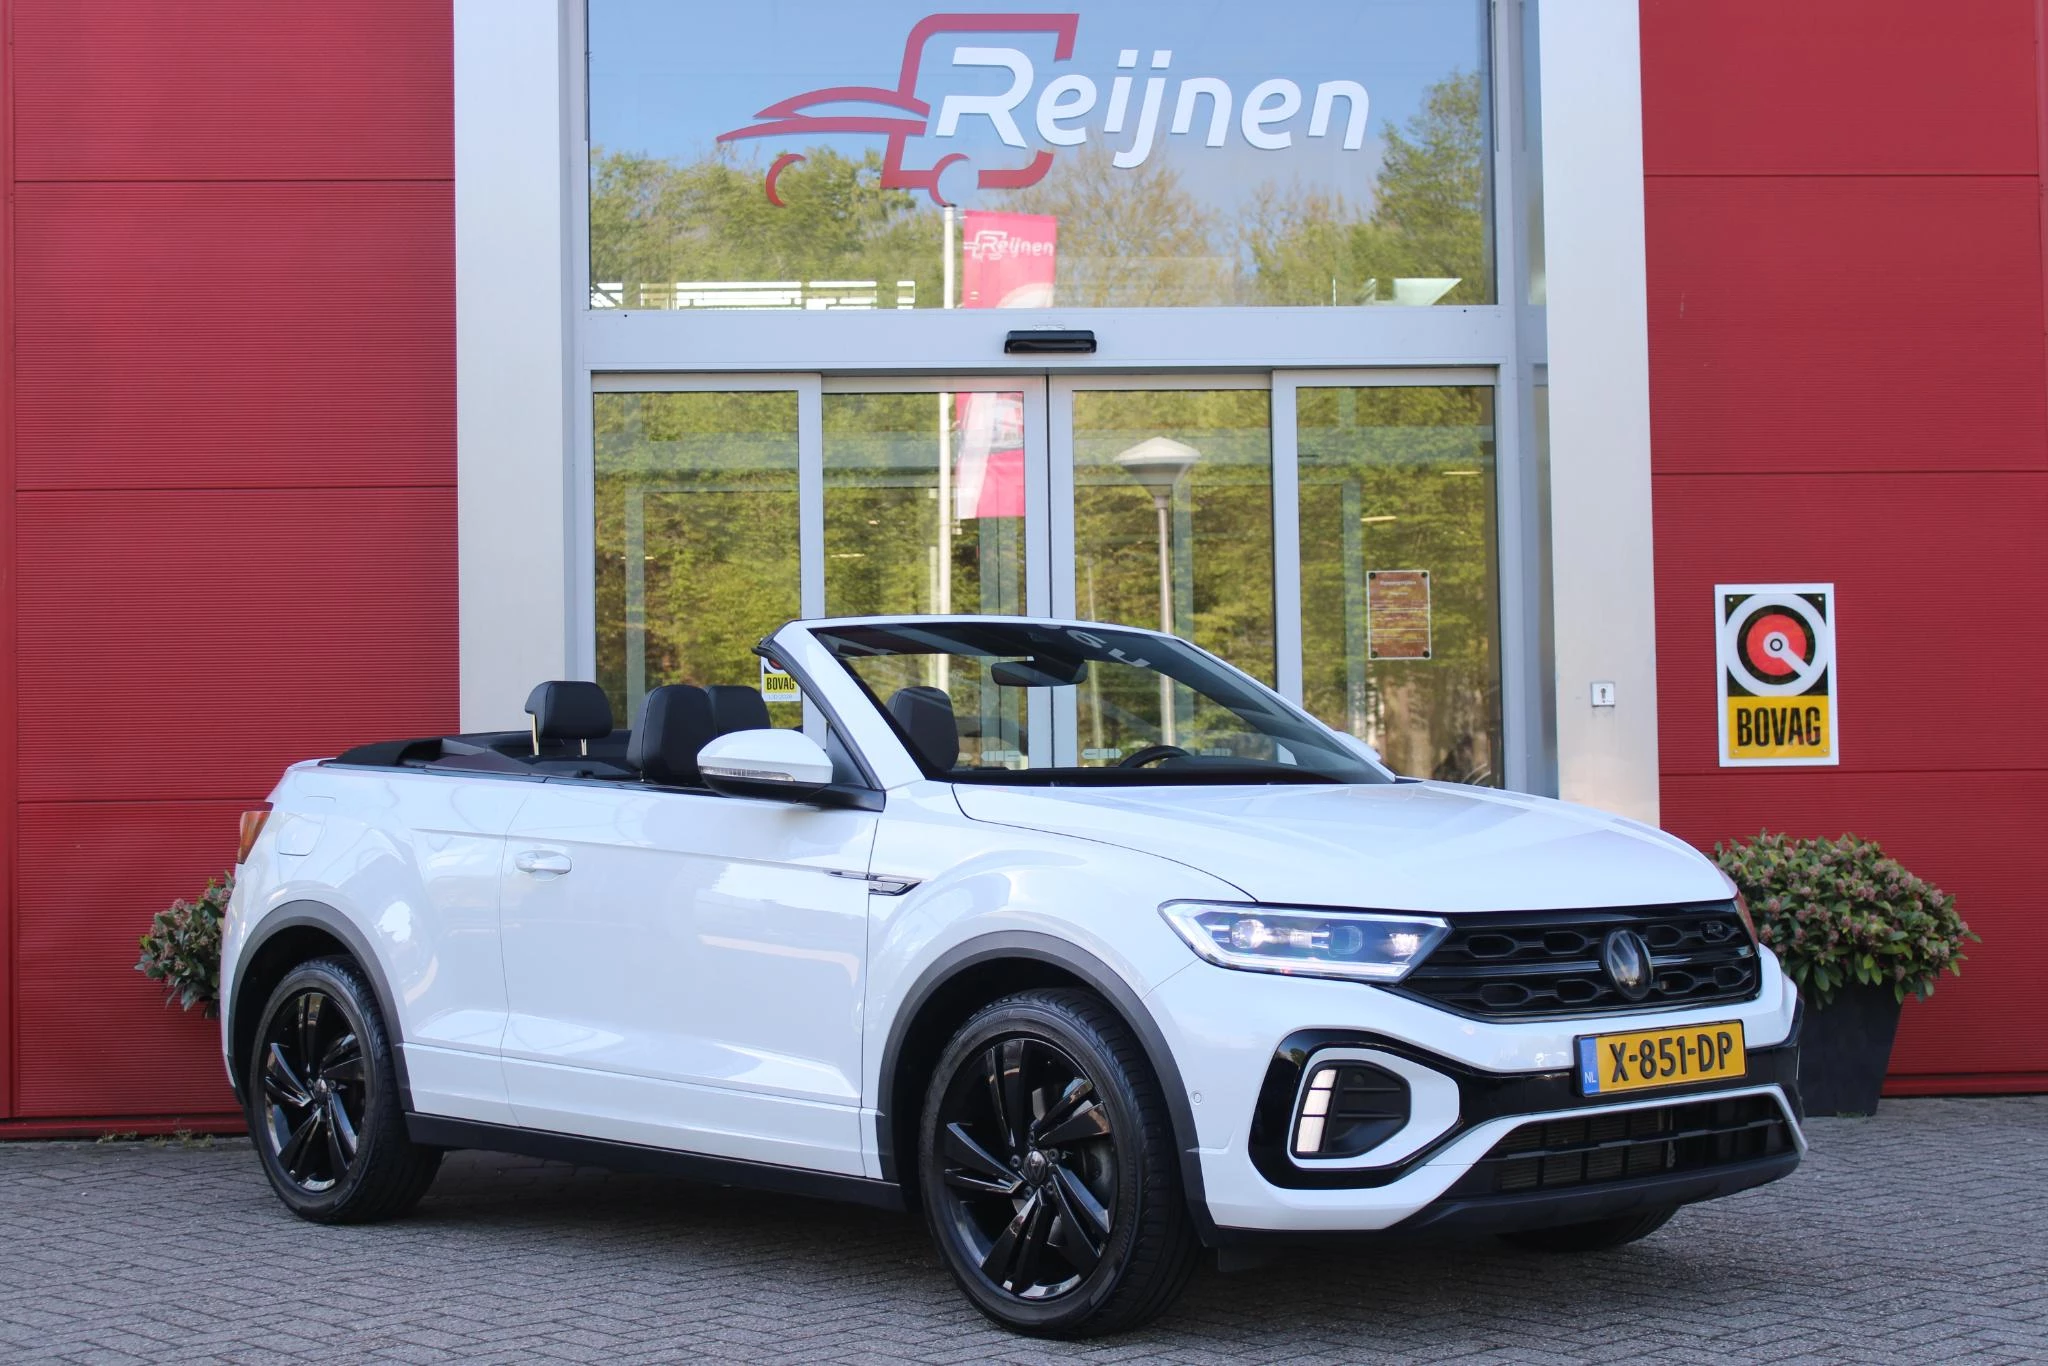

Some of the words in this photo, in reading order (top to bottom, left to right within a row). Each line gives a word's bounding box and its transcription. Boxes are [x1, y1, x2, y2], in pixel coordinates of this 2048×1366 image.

[936, 47, 1369, 168] Reijnen
[981, 235, 1054, 258] Reijnen
[766, 676, 795, 691] BOVAG
[1736, 706, 1821, 747] BOVAG
[1609, 1031, 1733, 1083] X-851-DP
[1584, 1071, 1597, 1084] NL
